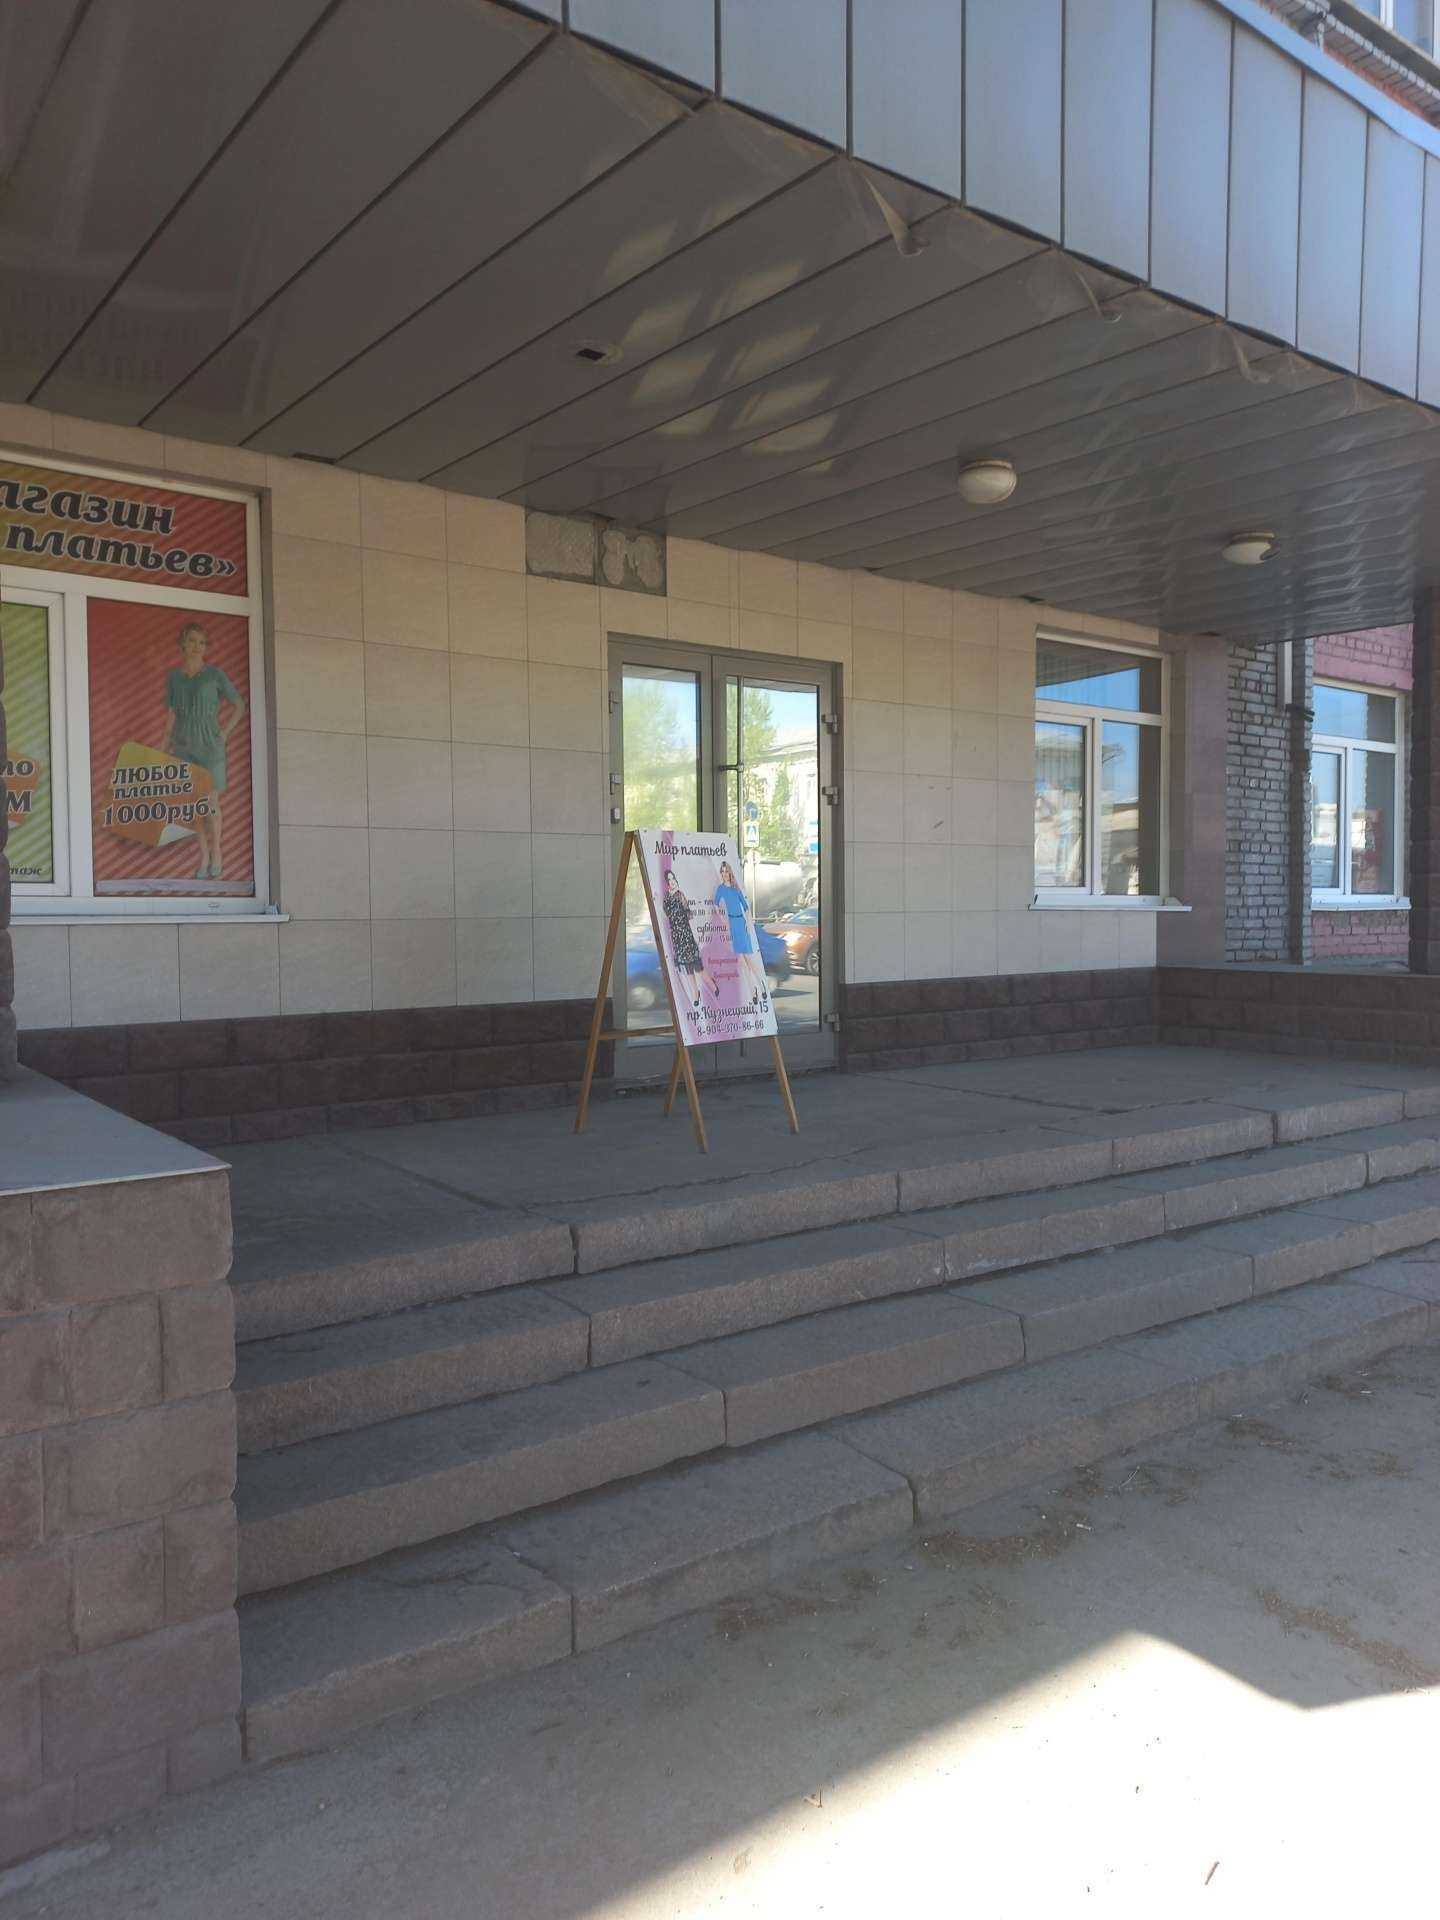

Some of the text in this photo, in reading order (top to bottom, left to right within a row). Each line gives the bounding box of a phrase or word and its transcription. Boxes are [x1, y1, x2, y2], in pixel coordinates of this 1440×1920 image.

[5, 523, 237, 577] платьев»
[112, 762, 191, 785] ЛЮБОЕ
[113, 782, 194, 800] платье
[103, 797, 216, 826] 1000руб.
[655, 840, 728, 861] Мир платьев
